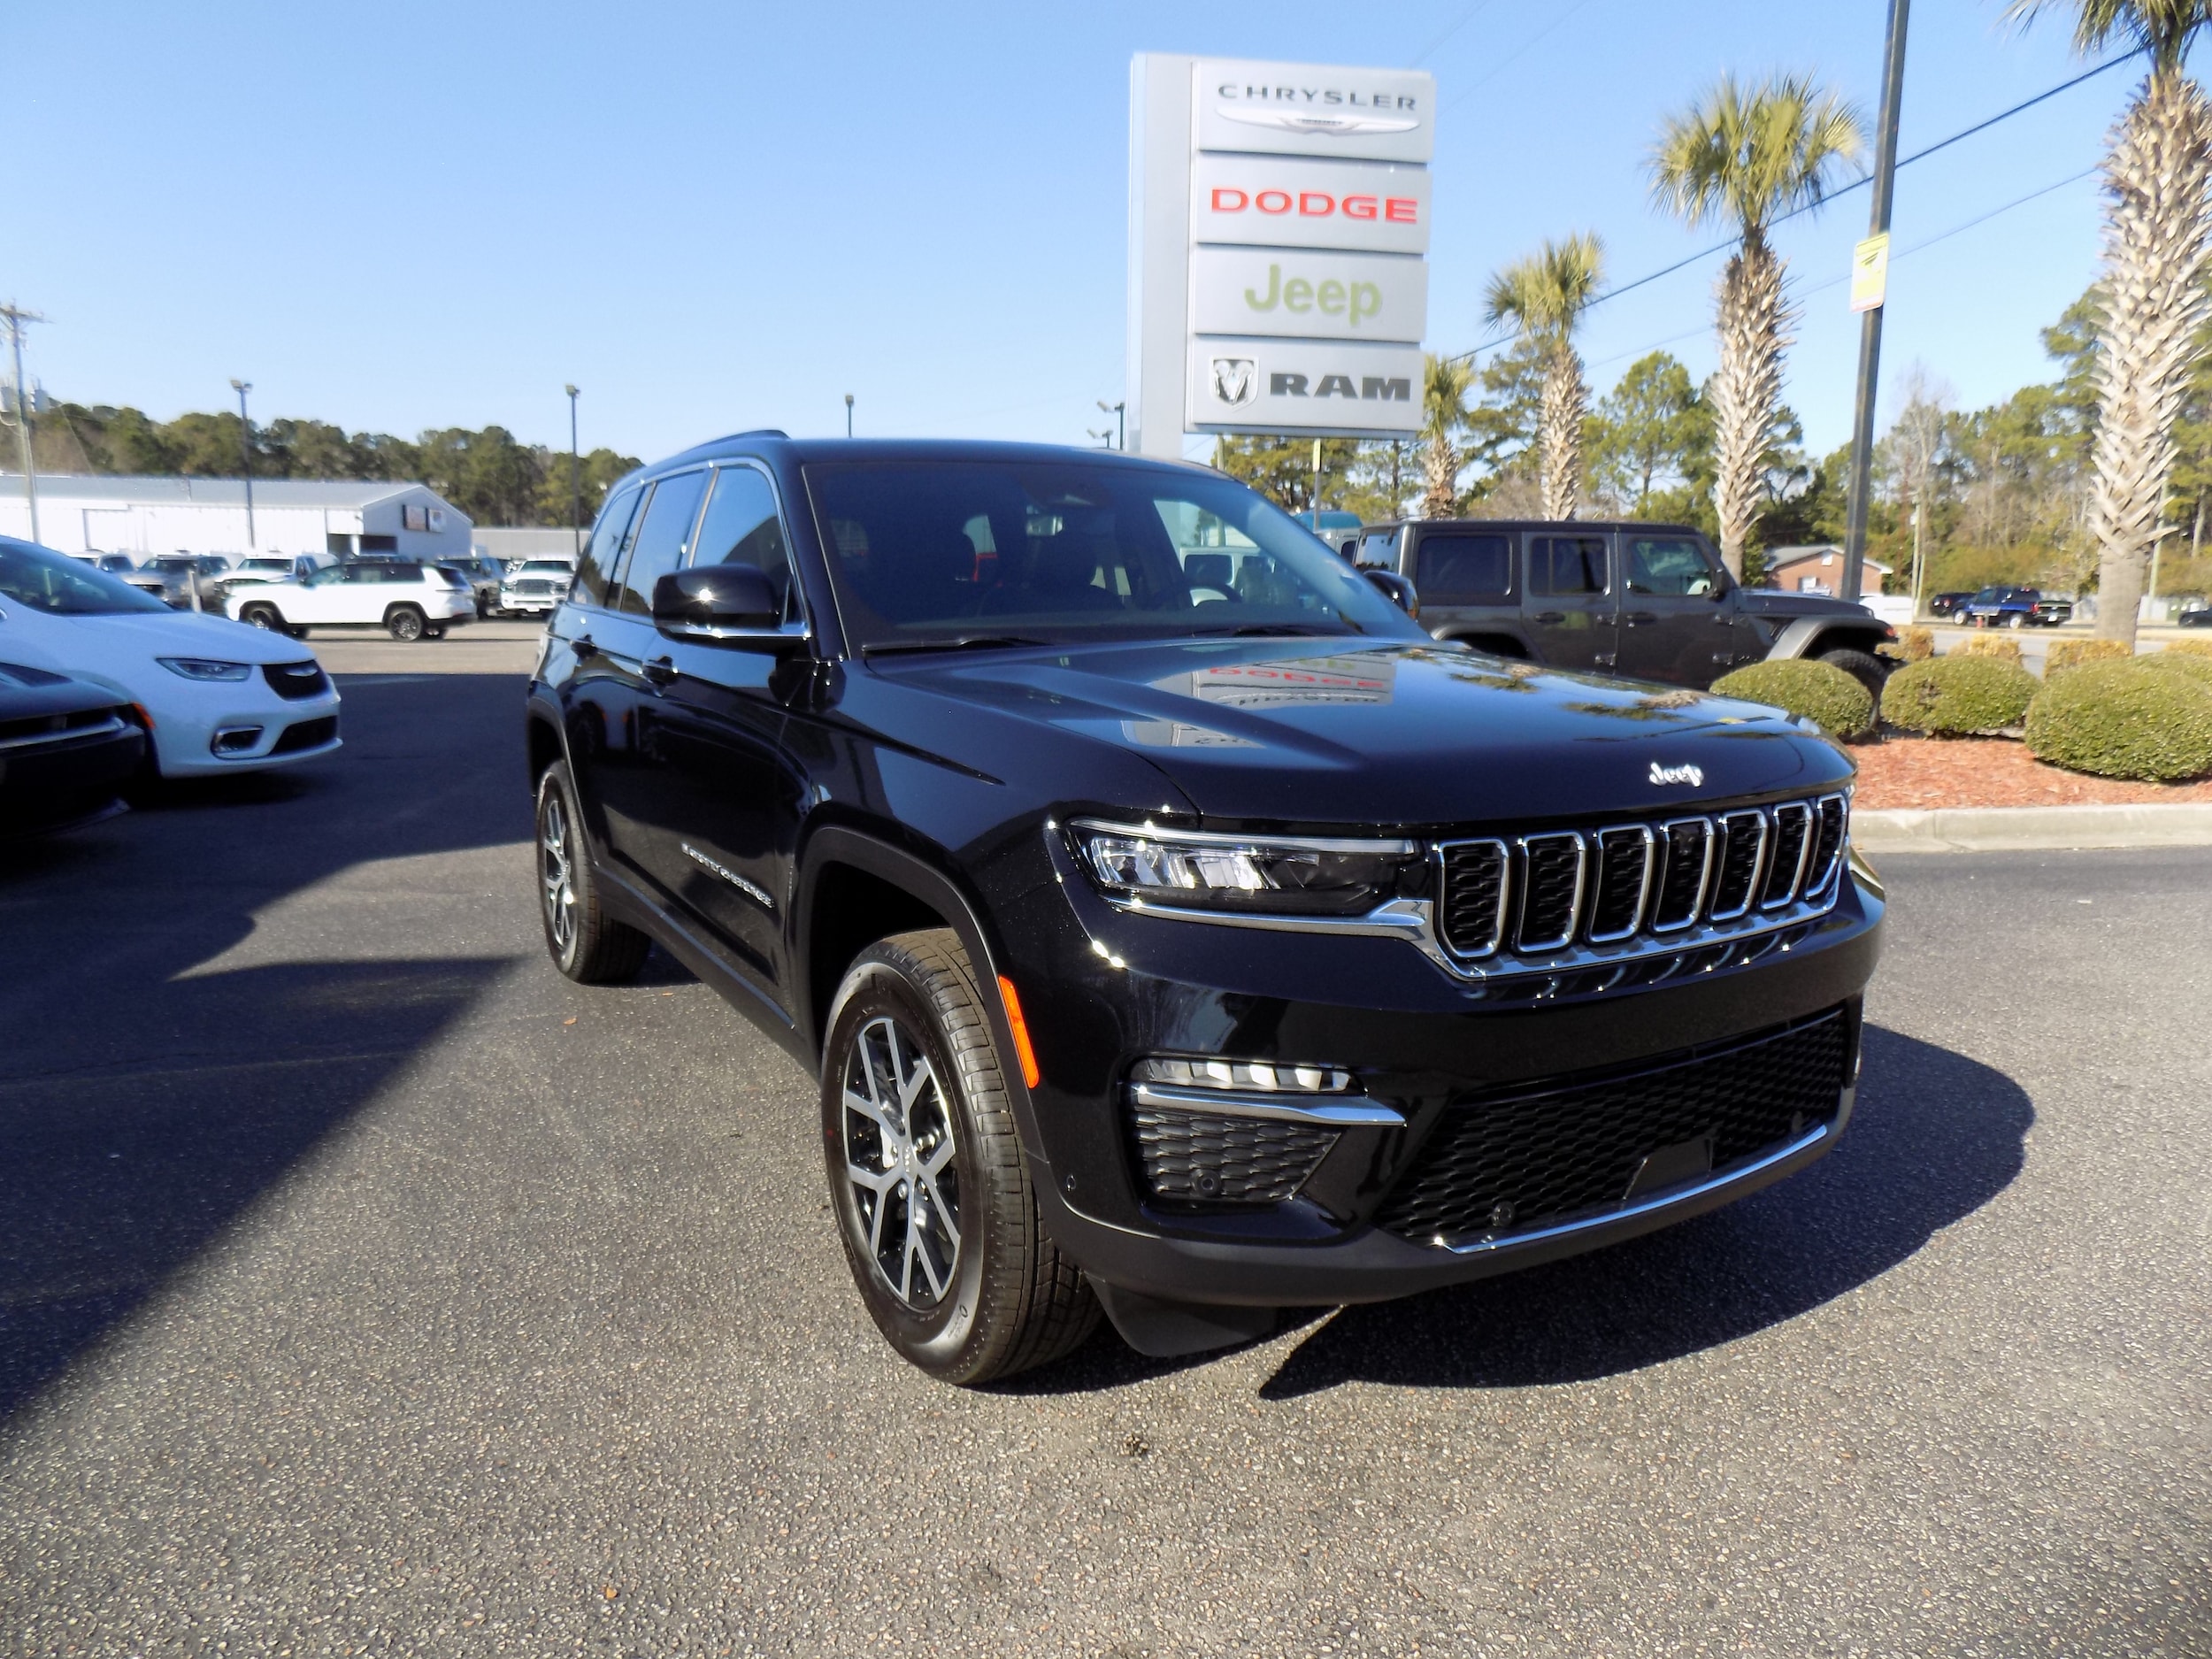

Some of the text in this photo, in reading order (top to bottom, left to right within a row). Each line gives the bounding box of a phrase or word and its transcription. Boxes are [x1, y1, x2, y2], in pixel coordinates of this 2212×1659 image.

[1218, 84, 1417, 111] CHRYSLER
[1211, 188, 1417, 223] DODGE
[1244, 263, 1382, 326] Jeep
[1271, 373, 1411, 402] RAM
[1648, 762, 1704, 787] Jeep
